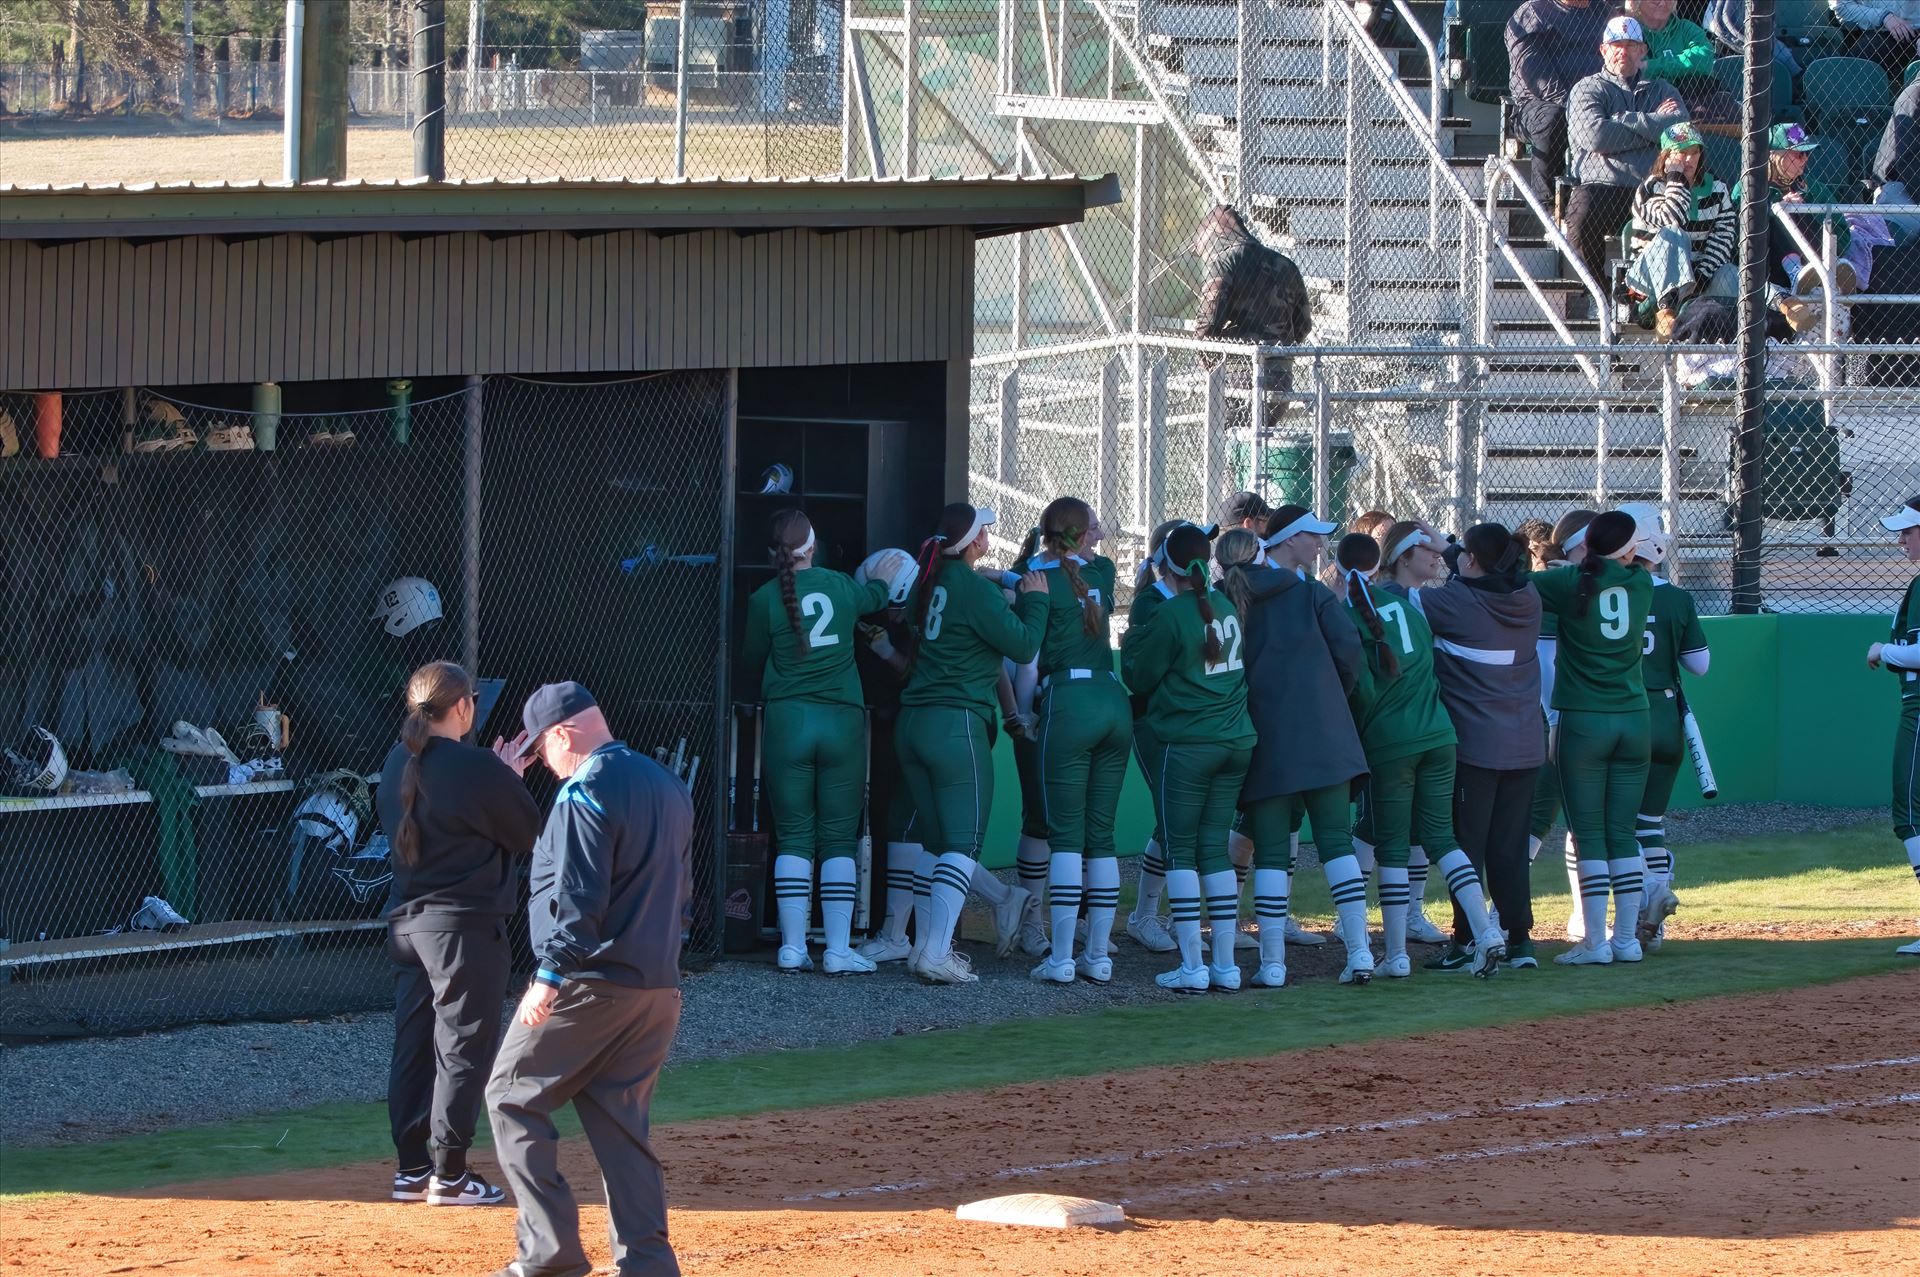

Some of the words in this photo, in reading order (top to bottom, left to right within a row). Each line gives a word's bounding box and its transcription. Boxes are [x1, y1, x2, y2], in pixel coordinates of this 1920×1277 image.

[801, 592, 840, 648] 2
[925, 585, 948, 641] 8
[1376, 601, 1415, 655] 7
[1599, 586, 1630, 640] 9
[1204, 614, 1244, 676] 22
